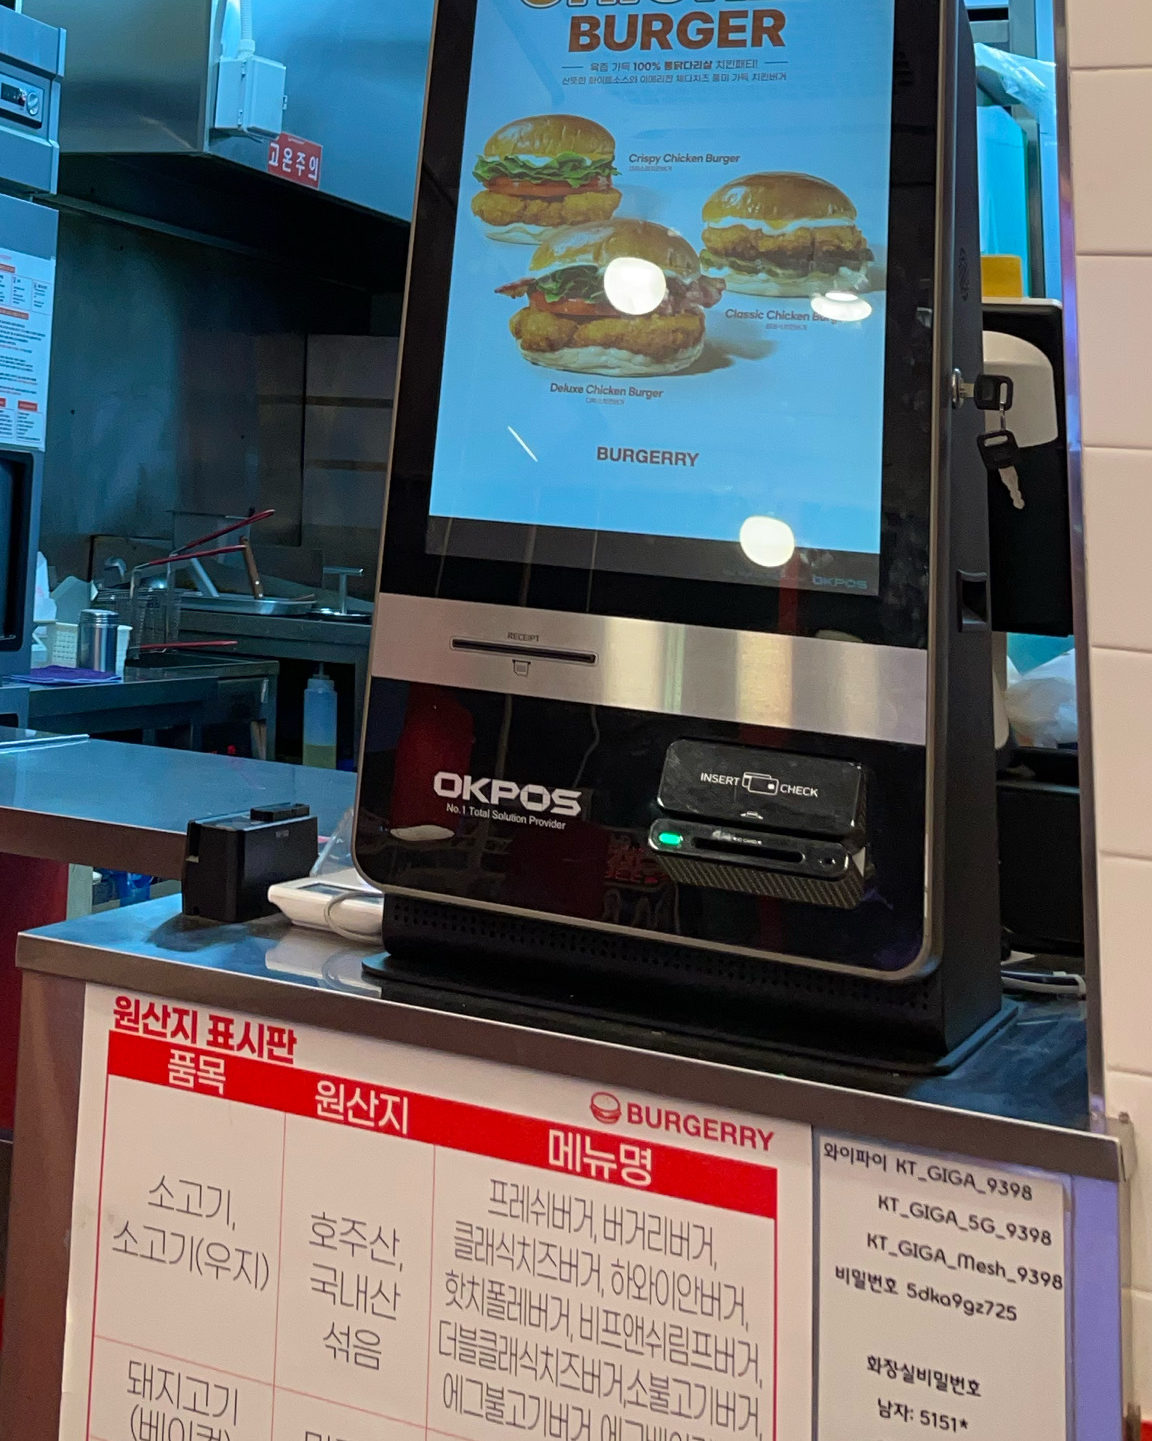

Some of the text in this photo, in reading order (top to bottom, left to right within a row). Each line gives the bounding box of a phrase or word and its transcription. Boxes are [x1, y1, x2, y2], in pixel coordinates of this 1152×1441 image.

[568, 8, 786, 53] BURGER
[633, 61, 661, 71] 100%
[269, 142, 318, 181] 고온주의
[629, 153, 741, 166] Crispy Chicken Burger
[725, 309, 810, 321] Classic Chicken
[550, 382, 663, 400] Deluxe Chicken Burger
[596, 446, 699, 466] BURGERRY
[812, 574, 867, 589] OKPOS
[433, 770, 582, 818] OKPOS
[700, 772, 818, 797] INSERT CHECK
[447, 803, 566, 830] No.1 Total Solution Provider
[113, 995, 297, 1065] 원산지 표시판
[168, 1049, 226, 1095] 품목
[315, 1081, 409, 1135] 원산지
[627, 1102, 774, 1151] BURGERRY
[549, 1129, 652, 1186] 메뉴명
[824, 1142, 1034, 1201] 와이파이 KT_GIGA_9398
[148, 1175, 236, 1230] 소고기,
[488, 1179, 717, 1271] 프레쉬버거, 버거리버거,
[878, 1195, 1052, 1246] KT_GIGA_5G_9398
[113, 1221, 270, 1291] 소고기(우지)
[309, 1212, 403, 1272] 호주산,
[867, 1233, 1063, 1290] KT_GIGA_Mesh_9398
[310, 1263, 401, 1320] 국내산
[454, 1220, 749, 1332] 클래식치즈버거, 하와이안버거,
[835, 1265, 898, 1295] 비밀번호
[323, 1322, 382, 1370] 섞음
[445, 1269, 762, 1389] 핫치폴레버거, 비프앤쉬림프버거,
[127, 1361, 238, 1426] 돼지고기
[867, 1355, 981, 1397] 화장실비밀번호
[878, 1398, 914, 1422] 남자:
